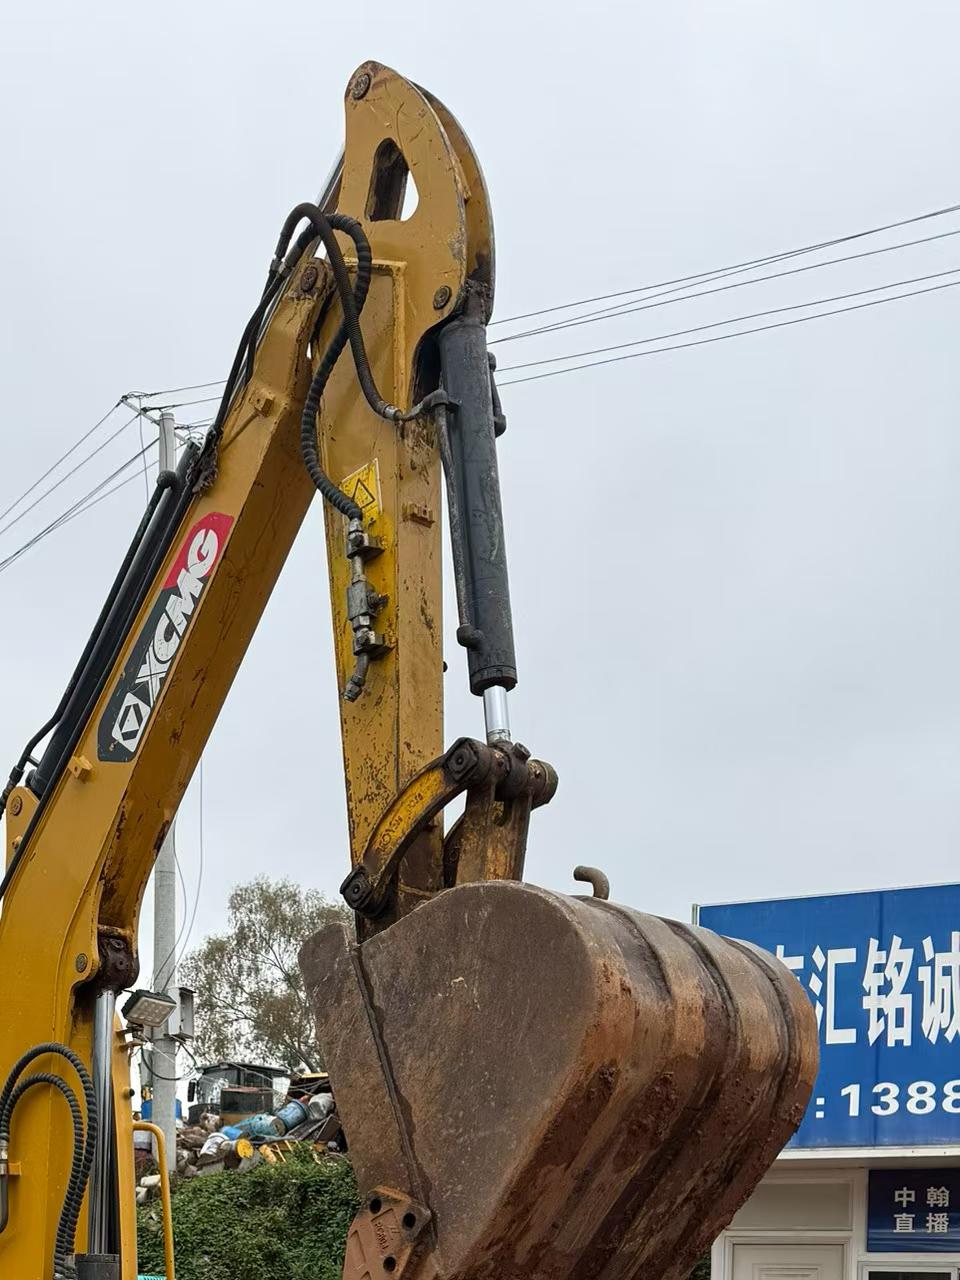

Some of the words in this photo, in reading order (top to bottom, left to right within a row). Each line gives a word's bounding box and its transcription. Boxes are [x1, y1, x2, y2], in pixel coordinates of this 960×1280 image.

[135, 527, 219, 708] XCMG
[776, 931, 960, 1047] 汇铭诚
[893, 1212, 950, 1233] 直播
